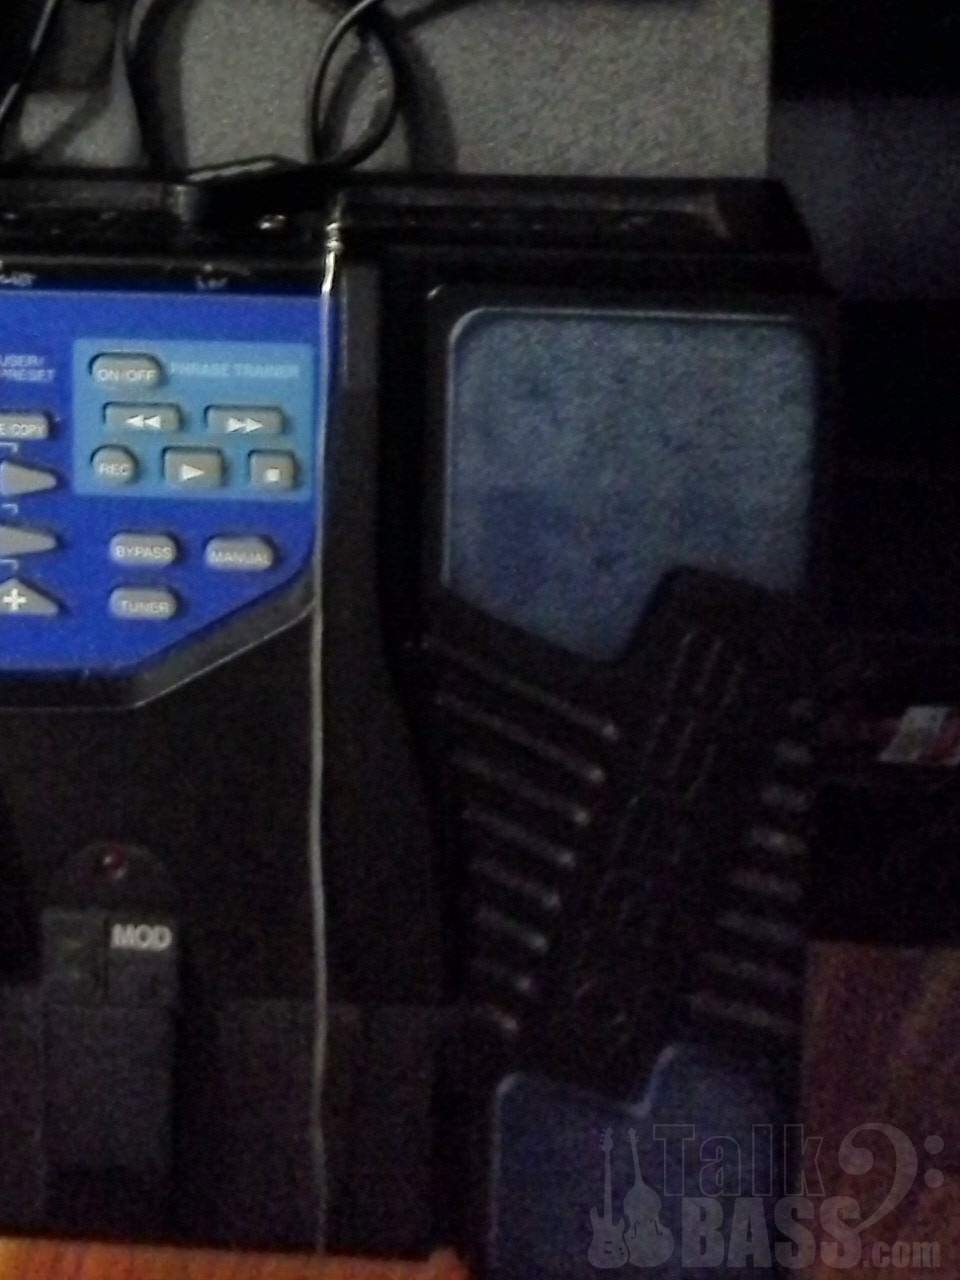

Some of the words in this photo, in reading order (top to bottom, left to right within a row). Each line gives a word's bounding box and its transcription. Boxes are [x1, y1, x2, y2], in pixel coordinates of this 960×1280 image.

[100, 462, 130, 476] REC
[115, 544, 173, 560] BYPASS
[211, 549, 270, 565] MANUAL
[120, 599, 170, 614] TUNER
[111, 923, 173, 951] MOD
